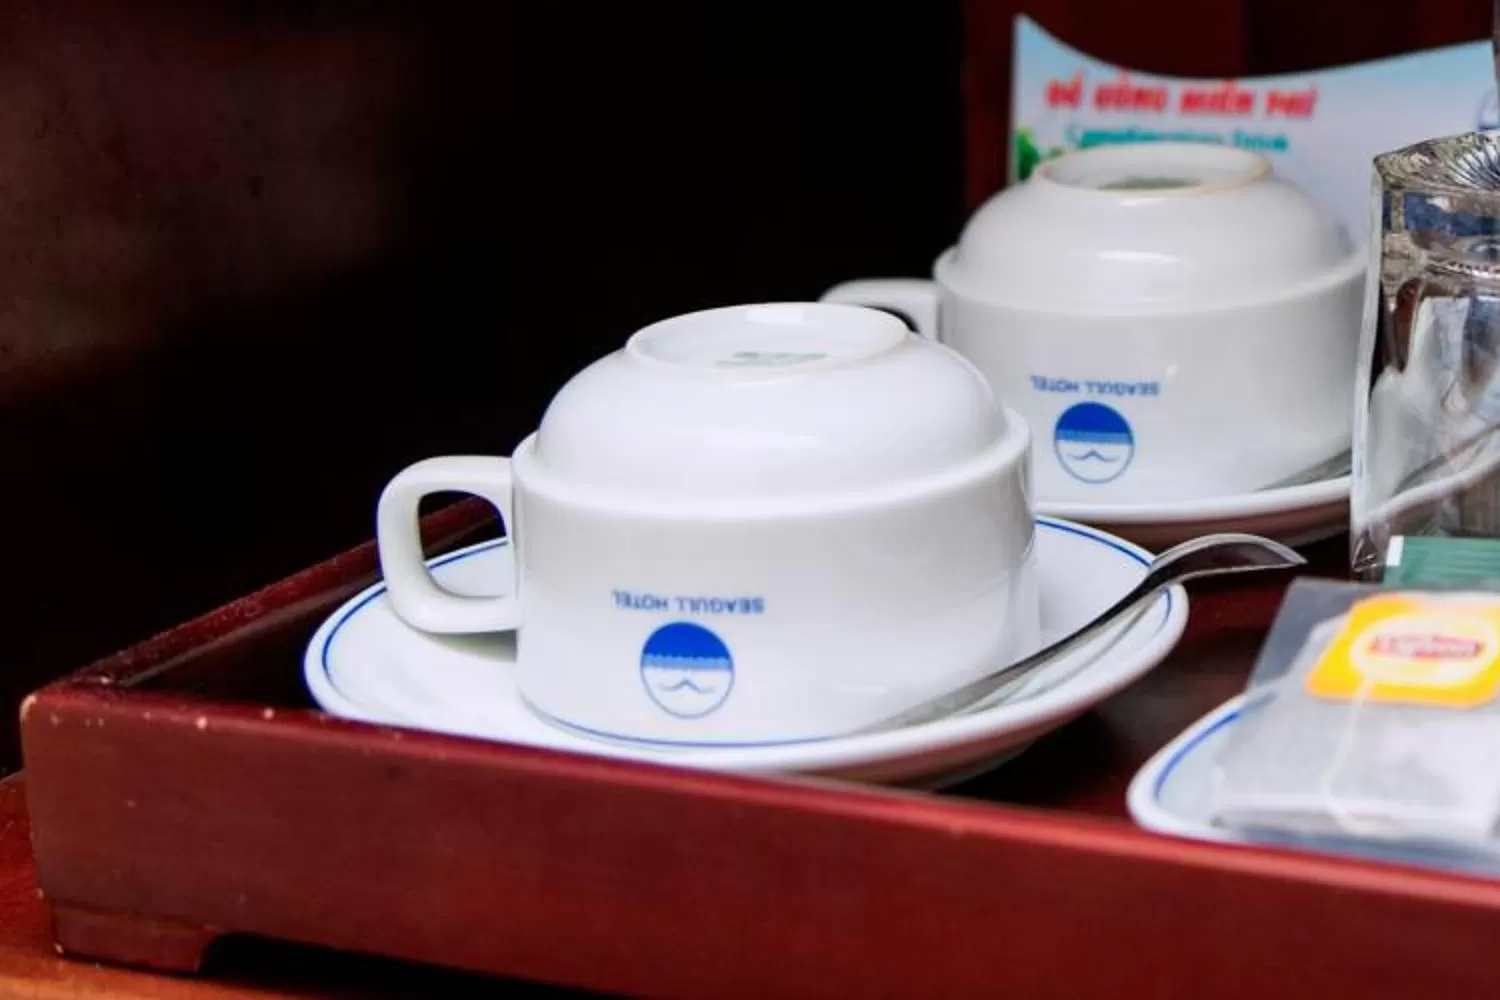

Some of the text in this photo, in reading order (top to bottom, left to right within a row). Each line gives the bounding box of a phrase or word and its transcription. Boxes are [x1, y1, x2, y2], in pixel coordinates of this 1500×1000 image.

[1030, 375, 1079, 393] HOTEL
[611, 589, 766, 614] SEAGULL HOTEL
